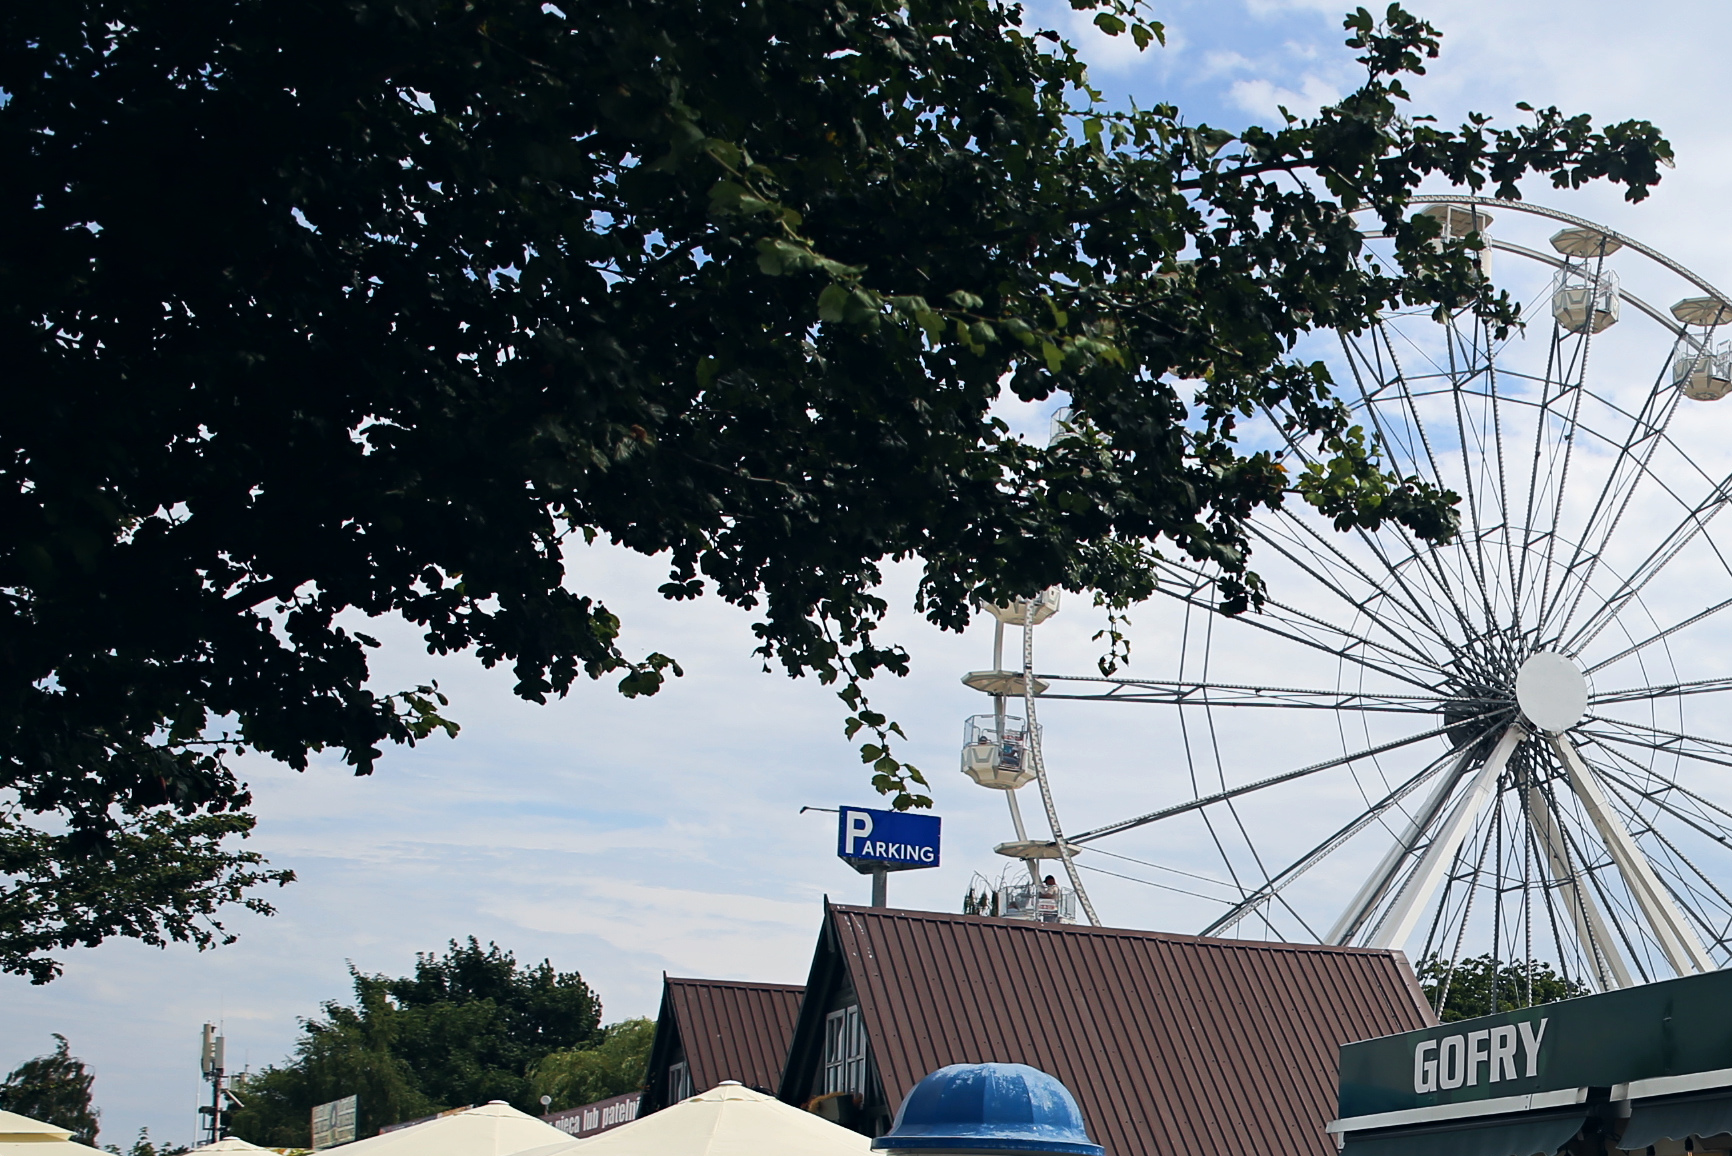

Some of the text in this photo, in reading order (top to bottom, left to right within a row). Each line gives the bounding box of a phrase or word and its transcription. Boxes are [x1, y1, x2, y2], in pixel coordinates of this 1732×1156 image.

[846, 811, 935, 862] PARKING
[1413, 1017, 1549, 1094] GOFRY
[583, 1107, 599, 1131] lub
